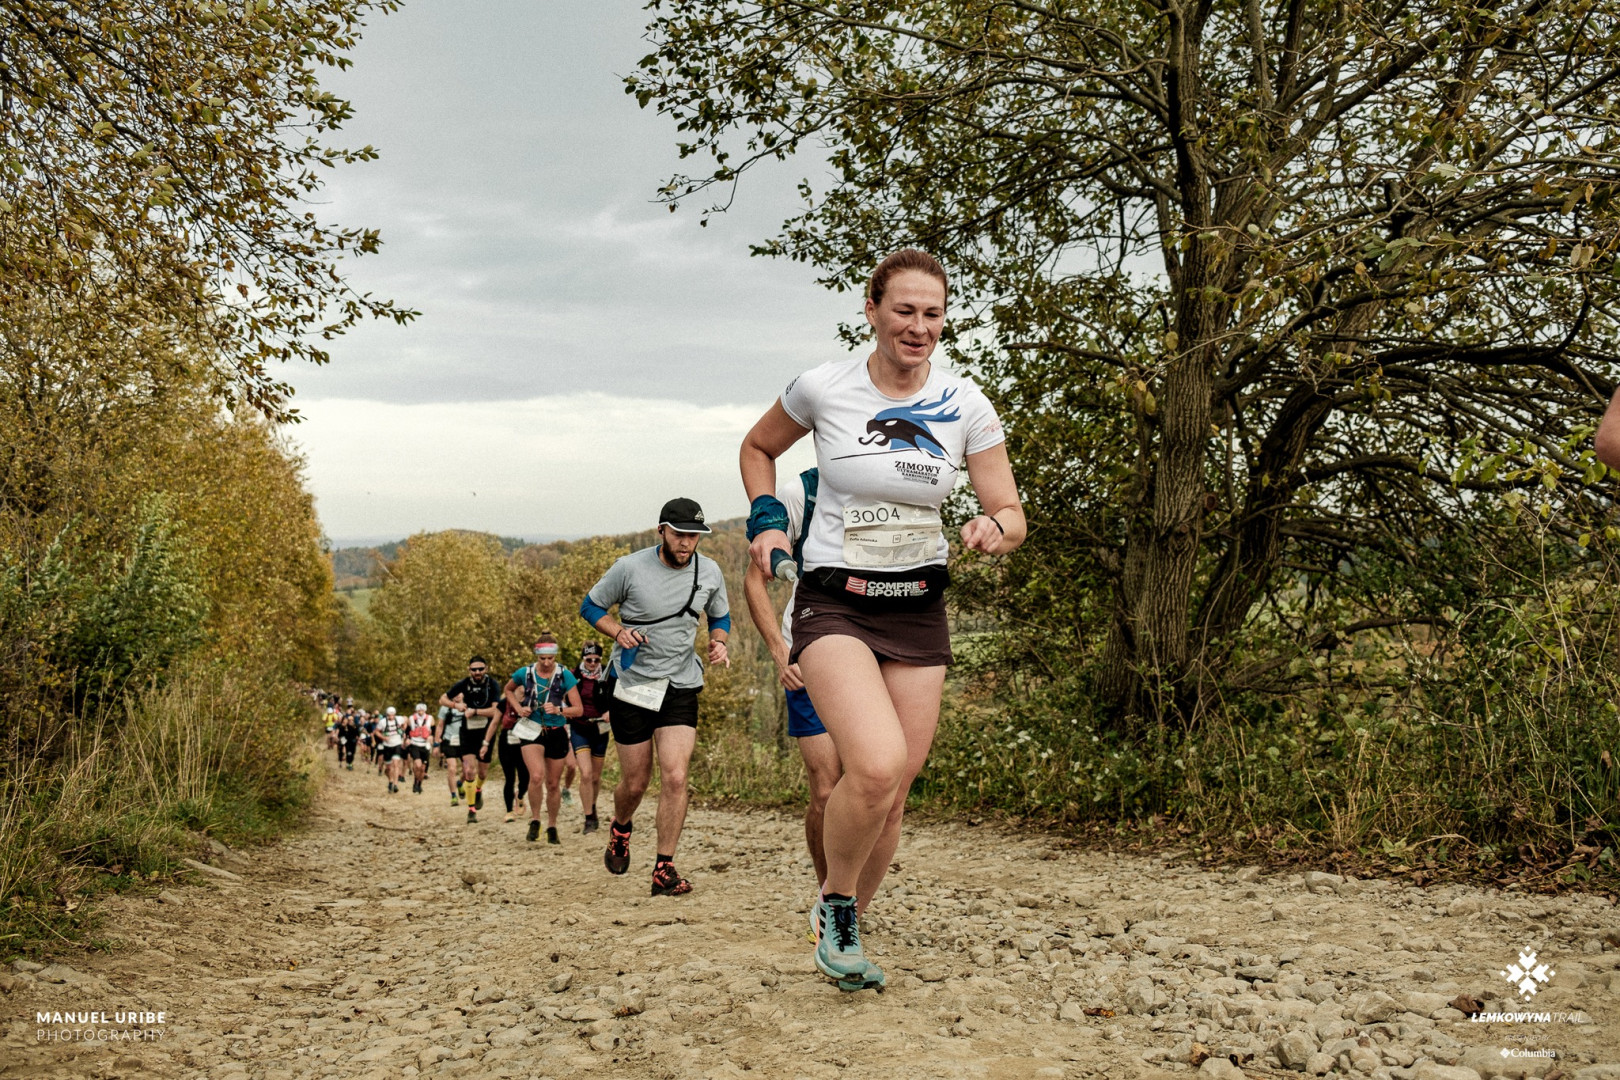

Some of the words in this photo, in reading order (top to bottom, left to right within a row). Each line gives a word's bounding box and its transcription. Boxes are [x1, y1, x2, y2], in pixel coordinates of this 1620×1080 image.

[895, 461, 941, 474] ZIMOWY
[850, 507, 900, 524] 3004
[867, 580, 927, 590] COMPRES
[866, 588, 910, 597] SPORT
